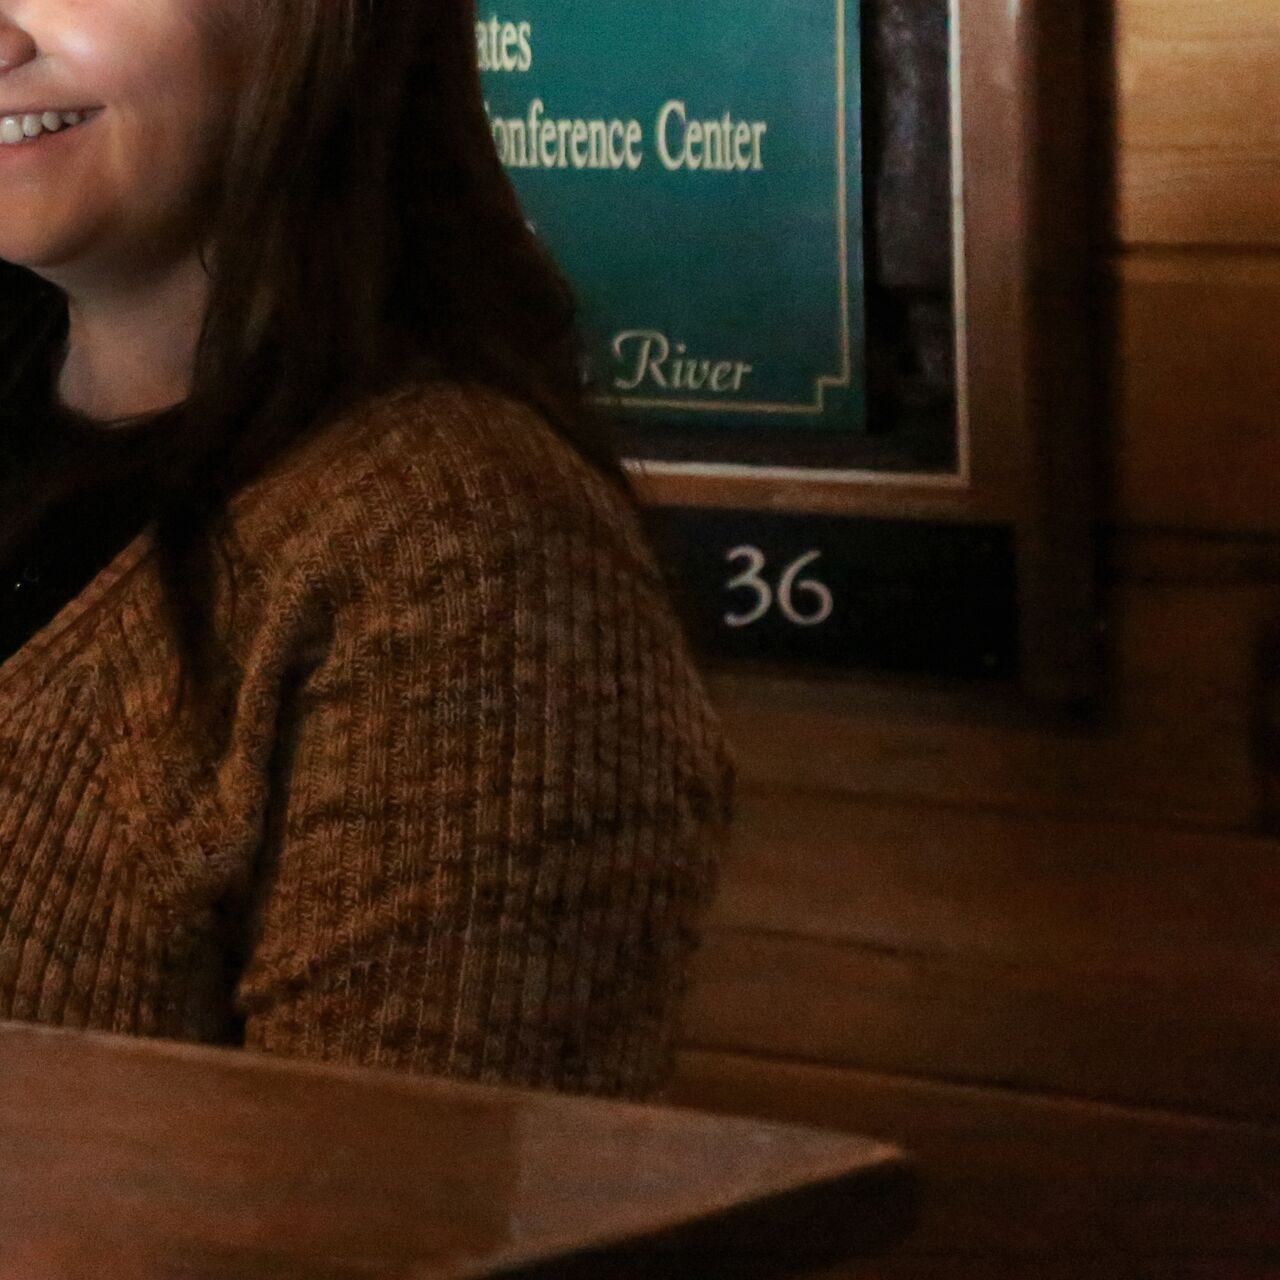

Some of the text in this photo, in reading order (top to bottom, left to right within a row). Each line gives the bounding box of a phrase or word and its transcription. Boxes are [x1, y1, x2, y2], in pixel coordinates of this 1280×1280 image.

[485, 98, 644, 170] onference
[657, 99, 768, 170] Center
[612, 328, 753, 392] River
[724, 544, 834, 628] 36
